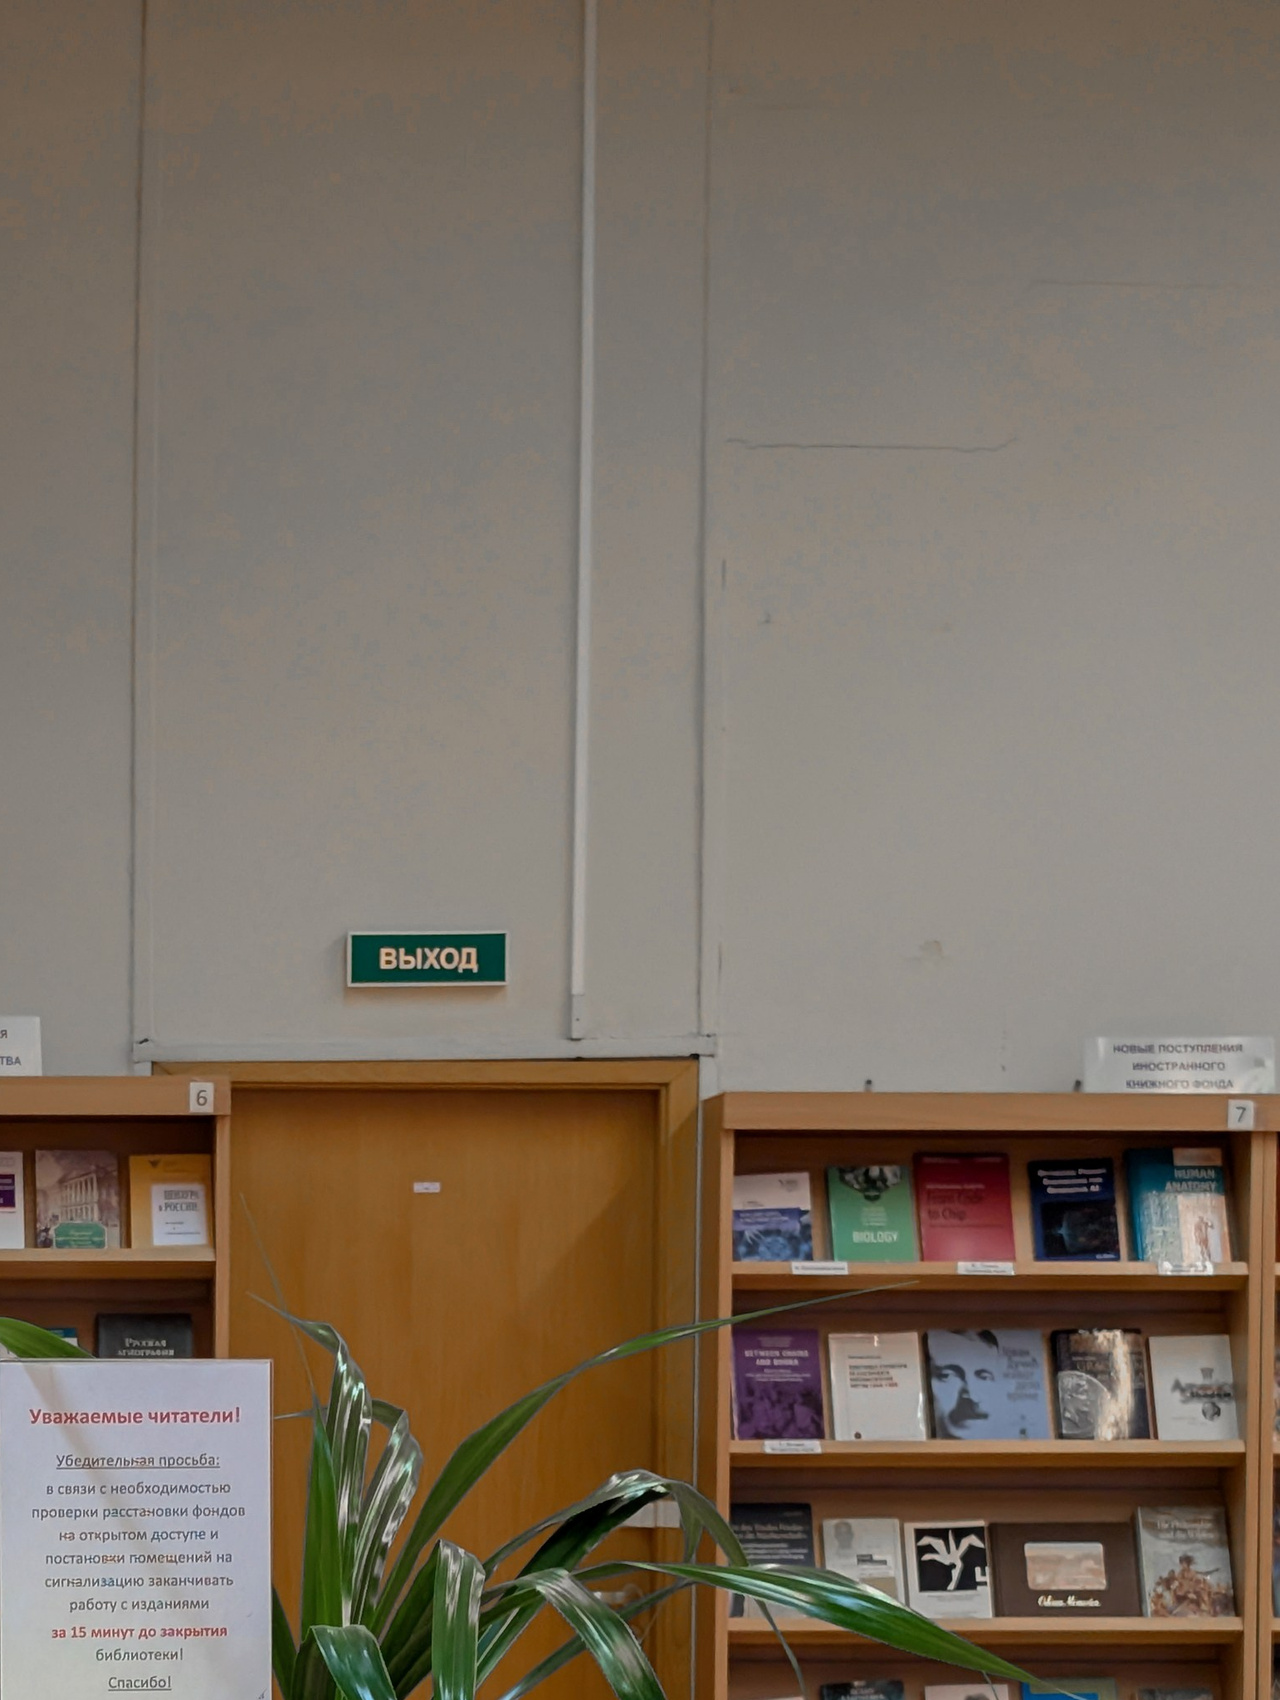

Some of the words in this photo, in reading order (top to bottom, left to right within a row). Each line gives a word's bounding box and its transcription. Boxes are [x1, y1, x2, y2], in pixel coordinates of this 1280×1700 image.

[380, 947, 478, 973] ВЫХОД
[1113, 1044, 1154, 1054] НОВЫЕ
[1158, 1044, 1243, 1053] ПОСТУПЛЕНИЯ
[1132, 1061, 1225, 1071] ИНОСТРАННОГО
[1126, 1079, 1189, 1089] КНИЖНОГО
[1192, 1079, 1234, 1089] ФОНДА
[196, 1090, 207, 1106] 6
[1236, 1106, 1246, 1122] 7
[853, 1231, 898, 1243] BIOLOGY
[29, 1409, 143, 1424] Уважаемые
[148, 1407, 239, 1423] читатели!
[56, 1453, 155, 1468] Убедительная
[159, 1453, 220, 1468] просьба:
[47, 1486, 53, 1494] в
[58, 1485, 95, 1494] связи
[100, 1485, 106, 1494] с
[111, 1482, 231, 1496] необходимостью
[32, 1509, 98, 1520] проверки
[103, 1508, 188, 1520] расстановки
[193, 1504, 245, 1519] фондов
[60, 1532, 75, 1541] на
[79, 1531, 147, 1543] открытом
[151, 1531, 206, 1543] доступе
[211, 1531, 218, 1539] и
[46, 1555, 124, 1564] постановки
[130, 1551, 211, 1565] помещений
[217, 1554, 232, 1562] на
[45, 1578, 144, 1589] сигнализацию
[149, 1577, 233, 1586] заканчивать
[70, 1598, 117, 1613] работу
[121, 1601, 127, 1610] с
[132, 1600, 209, 1612] изданиями
[52, 1629, 66, 1638] за
[71, 1627, 86, 1638] 15
[91, 1629, 135, 1640] минут
[138, 1628, 156, 1640] до
[160, 1627, 227, 1639] закрытия
[96, 1648, 183, 1661] библиотеки!
[108, 1675, 171, 1690] Спасибо!
